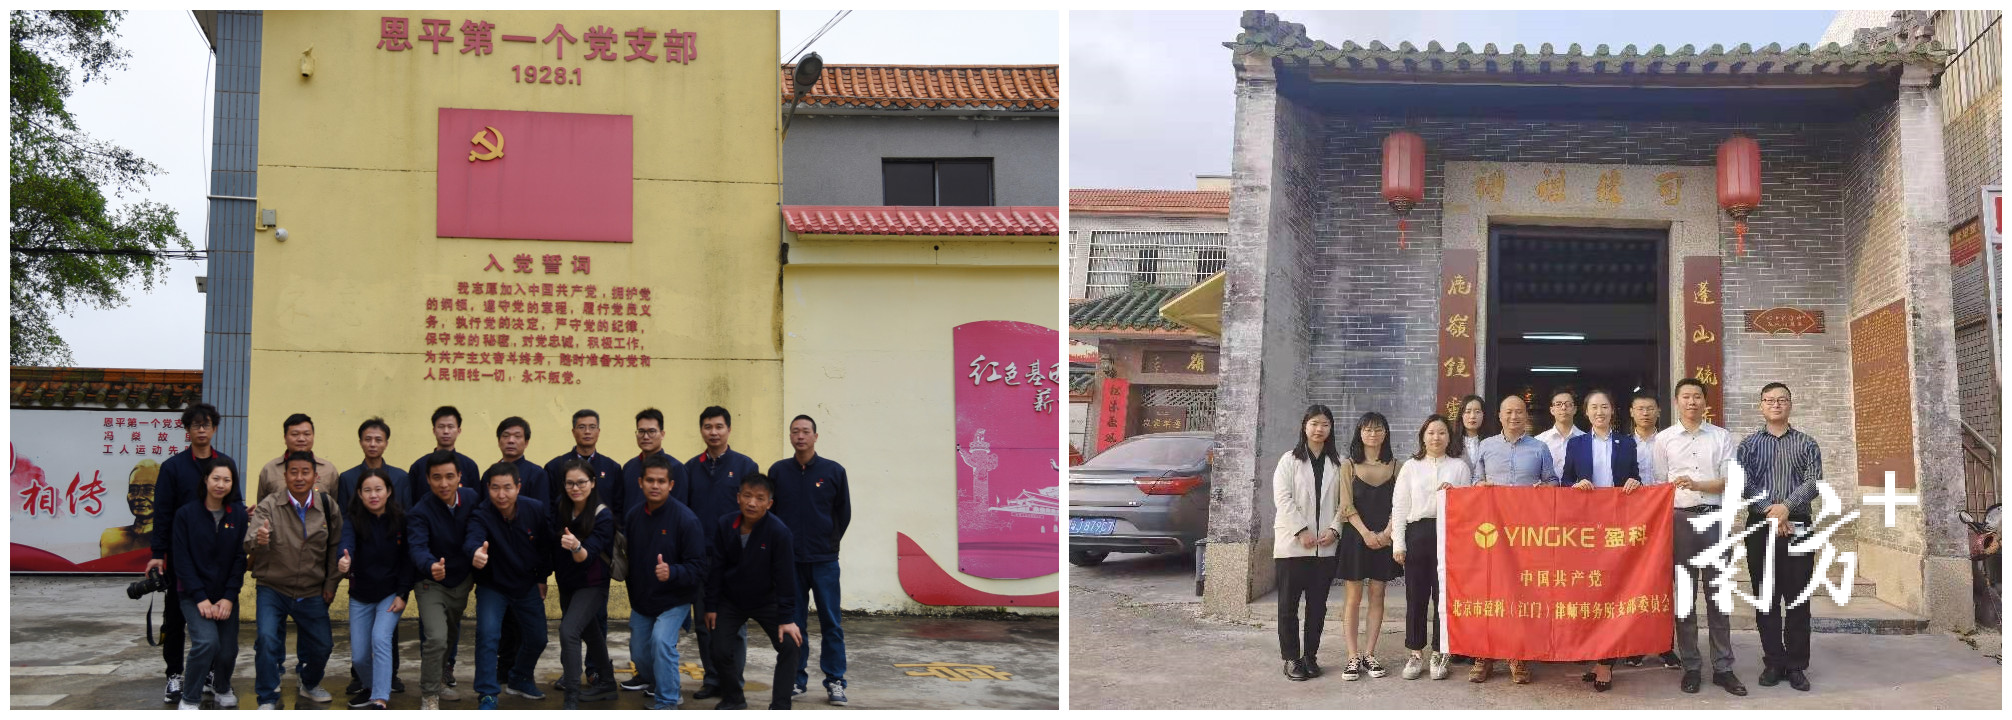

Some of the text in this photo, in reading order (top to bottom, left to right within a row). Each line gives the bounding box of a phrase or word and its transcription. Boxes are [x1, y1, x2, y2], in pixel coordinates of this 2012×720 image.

[377, 16, 697, 65] 恩平第一个党支部
[511, 65, 582, 85] 1928.1
[484, 253, 591, 275] 入党誓词
[102, 444, 190, 456] 工人运动先
[19, 469, 107, 516] 相传
[1503, 524, 1647, 548] YINGKE 盈科
[1519, 569, 1603, 587] 中国共产党
[1452, 594, 1669, 620] 北京市盈科（江门）律师事务所支部委员会
